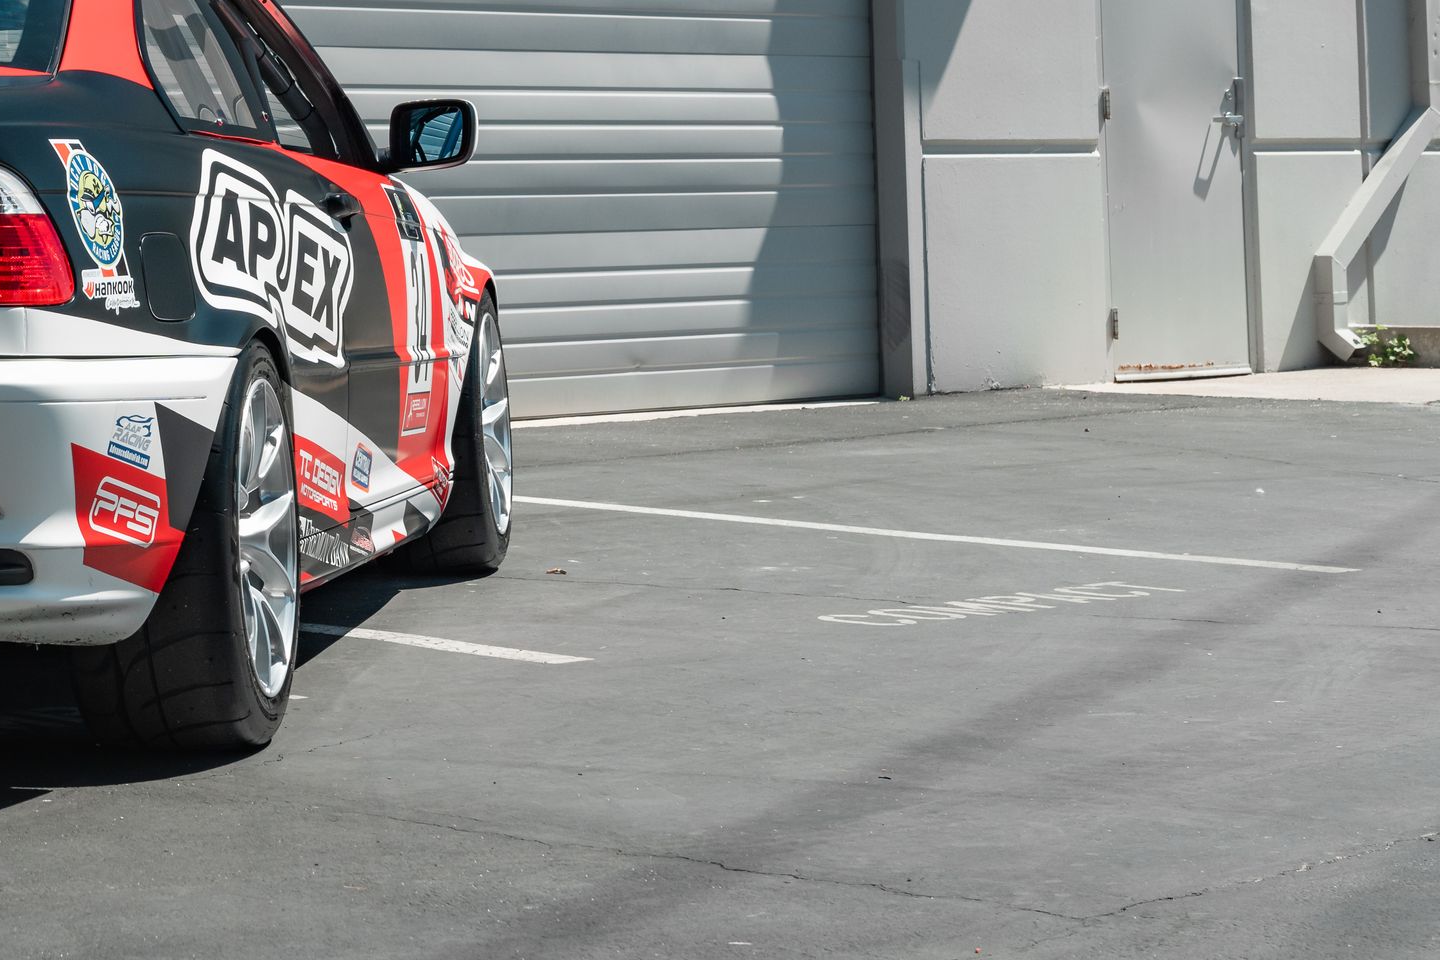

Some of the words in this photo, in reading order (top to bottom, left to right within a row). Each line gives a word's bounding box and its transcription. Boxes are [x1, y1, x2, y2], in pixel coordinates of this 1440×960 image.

[70, 154, 85, 204] LUCKY
[211, 186, 346, 337] APEX
[112, 427, 152, 452] RACING
[311, 457, 343, 498] DESIGN
[93, 487, 160, 537] PFS
[817, 581, 1187, 628] COMPACT
